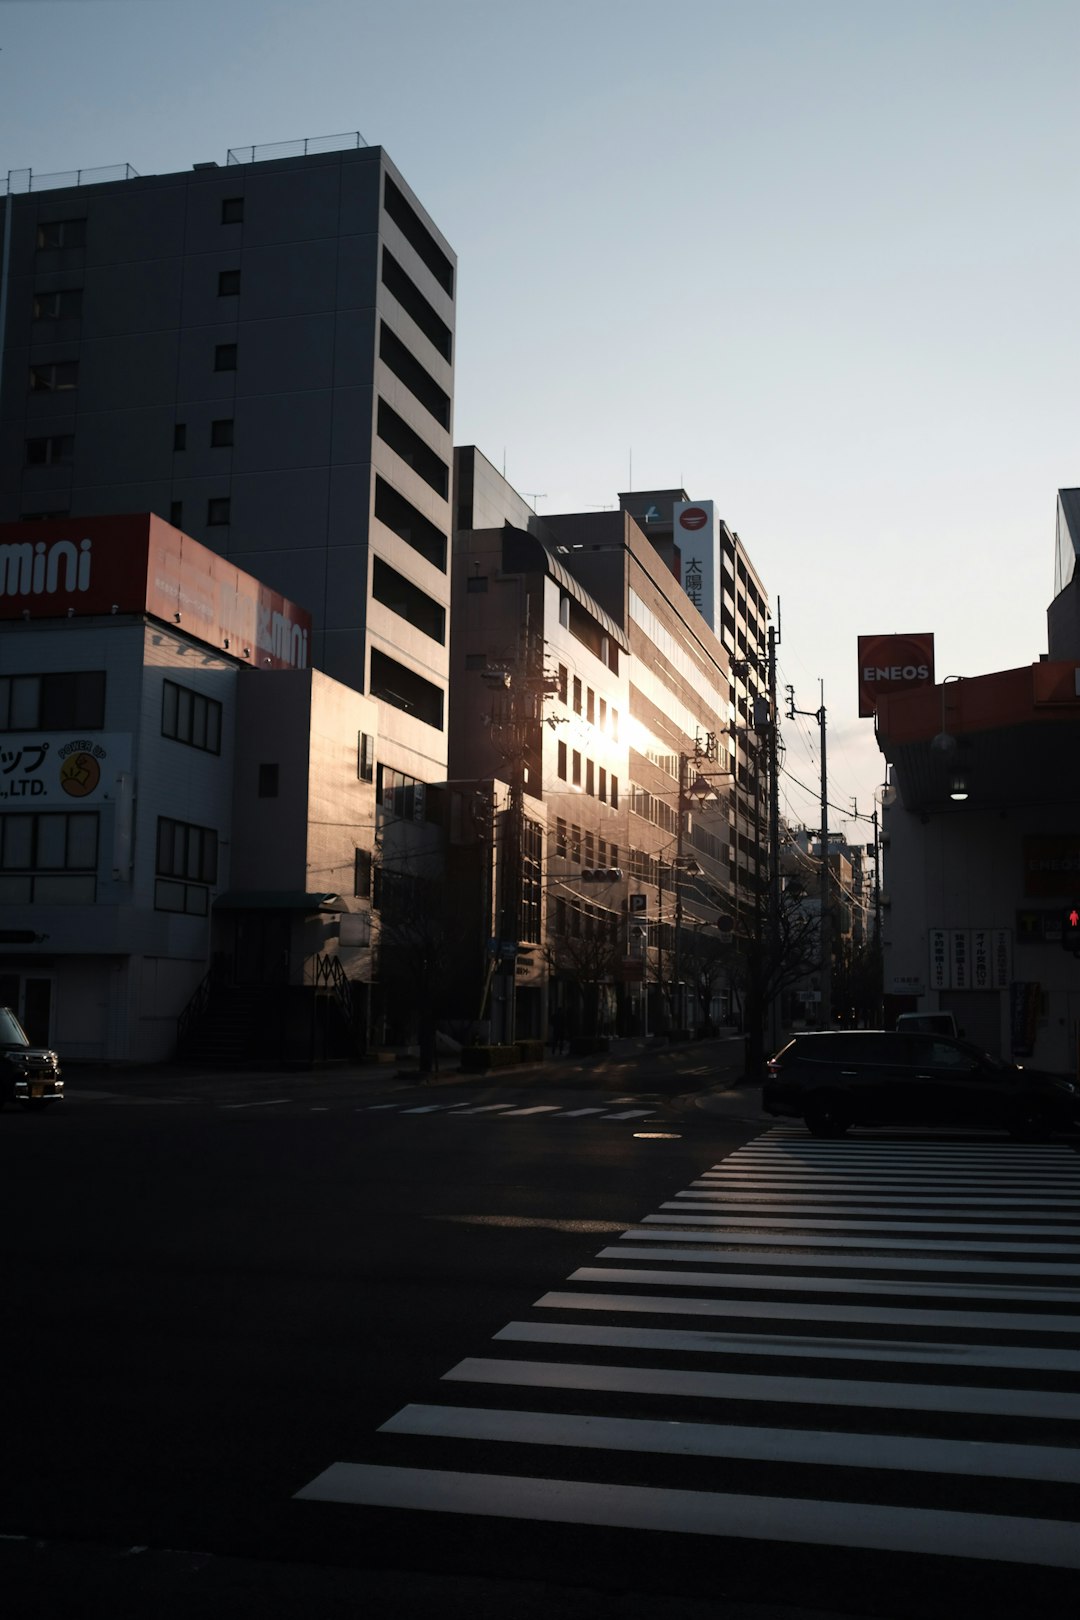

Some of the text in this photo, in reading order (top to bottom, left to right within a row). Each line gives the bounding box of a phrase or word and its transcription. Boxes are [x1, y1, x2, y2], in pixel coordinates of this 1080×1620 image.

[685, 557, 703, 613] 太陽生
[864, 664, 929, 681] ENEOS
[0, 742, 50, 774] ップ
[58, 740, 93, 759] POWER
